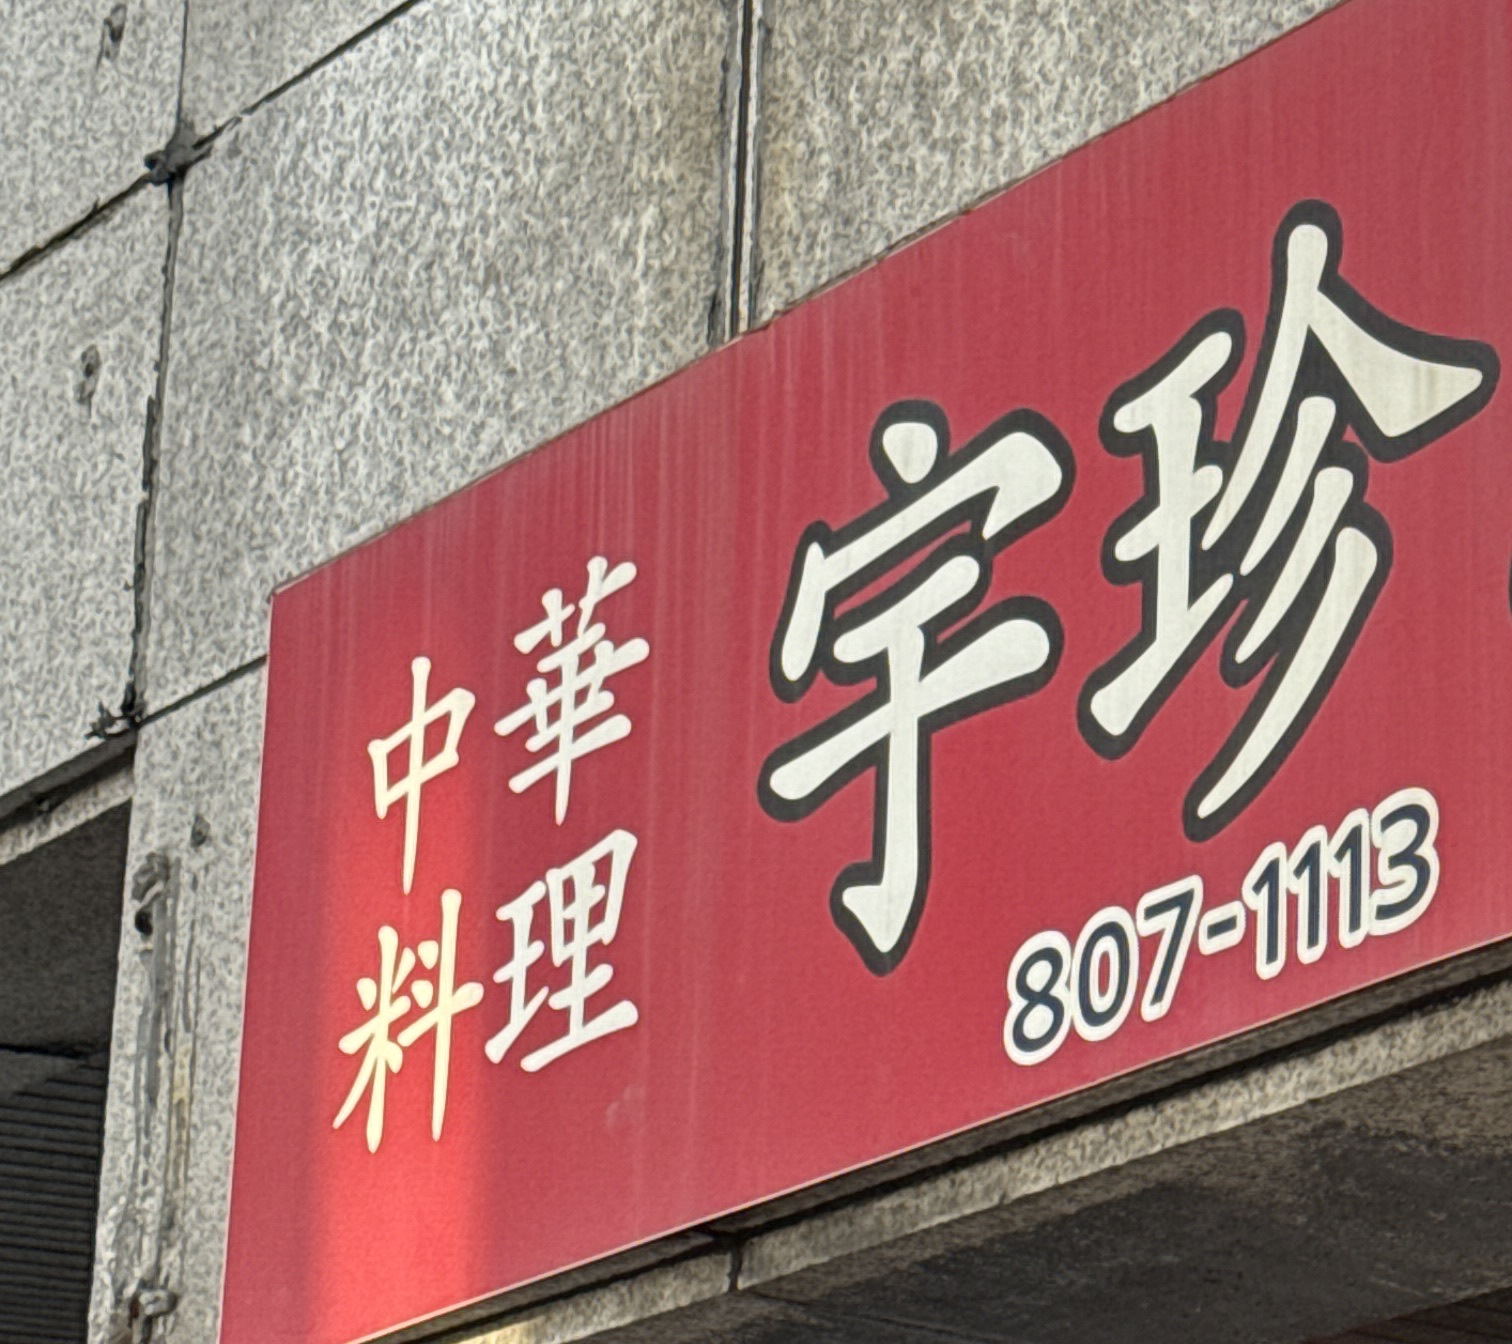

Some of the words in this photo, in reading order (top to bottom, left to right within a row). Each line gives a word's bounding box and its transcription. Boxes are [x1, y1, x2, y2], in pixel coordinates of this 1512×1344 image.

[367, 555, 651, 896] 中華
[330, 827, 640, 1154] 料理
[1003, 786, 1439, 1064] 807-1113
